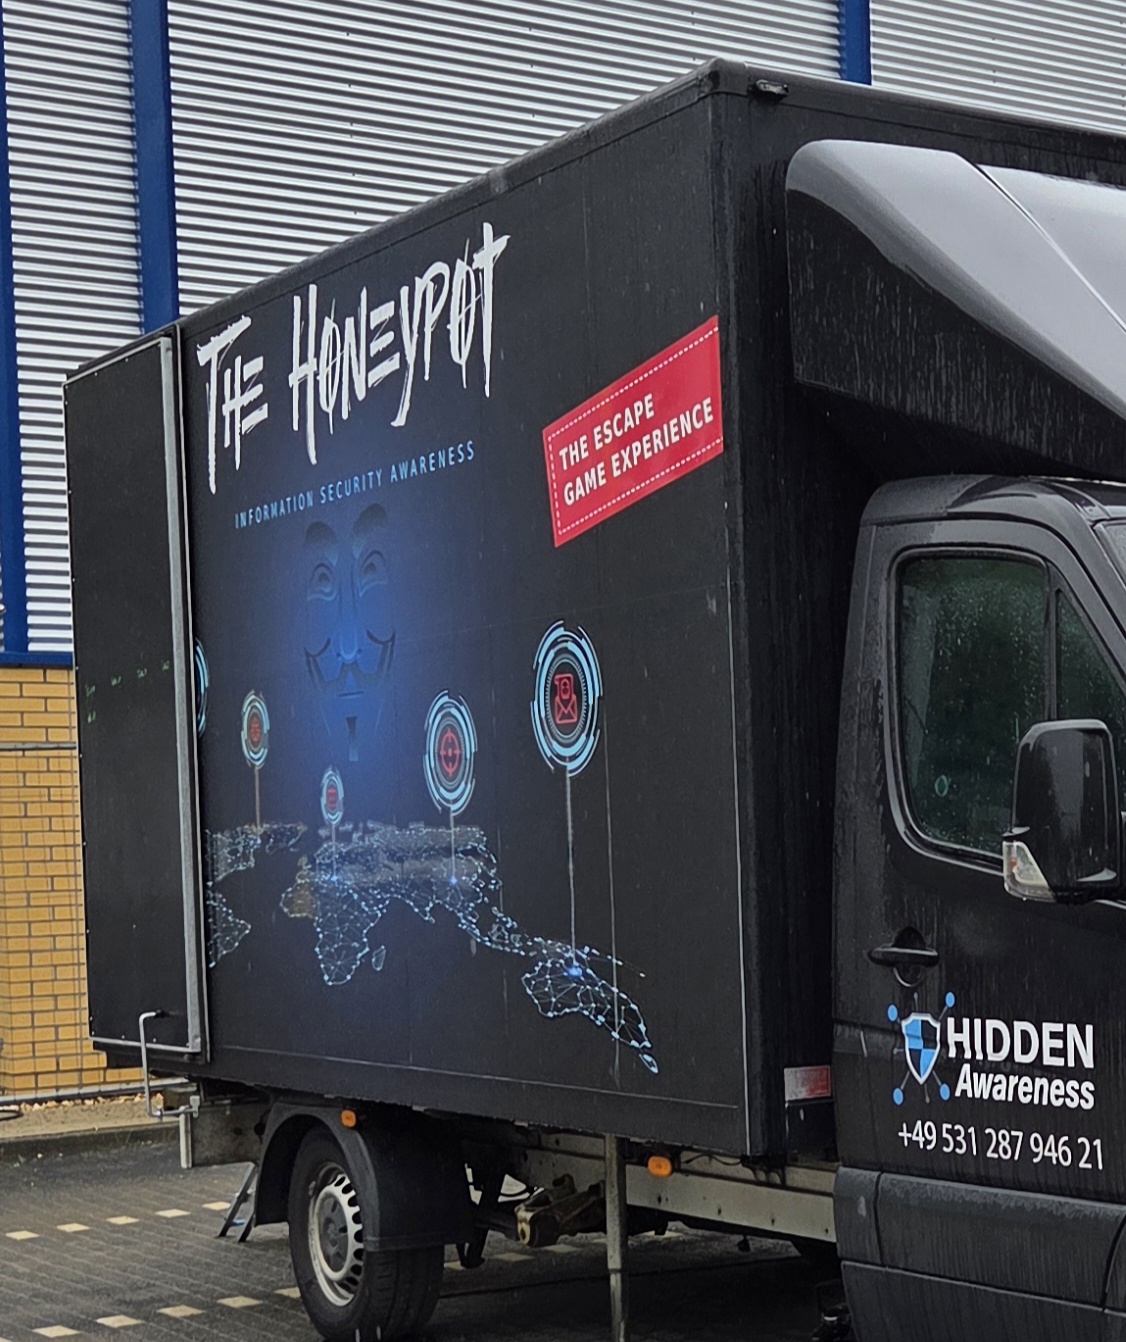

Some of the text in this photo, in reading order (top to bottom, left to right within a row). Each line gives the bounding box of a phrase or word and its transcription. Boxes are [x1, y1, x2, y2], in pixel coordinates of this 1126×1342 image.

[558, 393, 655, 470] THE ESCAPE
[563, 397, 714, 506] GAME EXPERIENCE
[234, 440, 475, 529] INFORMATION SECURITY AWARENESS
[947, 1017, 1095, 1069] HIDDEN
[954, 1063, 1095, 1110] Awareness
[898, 1120, 1103, 1170] +49 531 287 946 21
